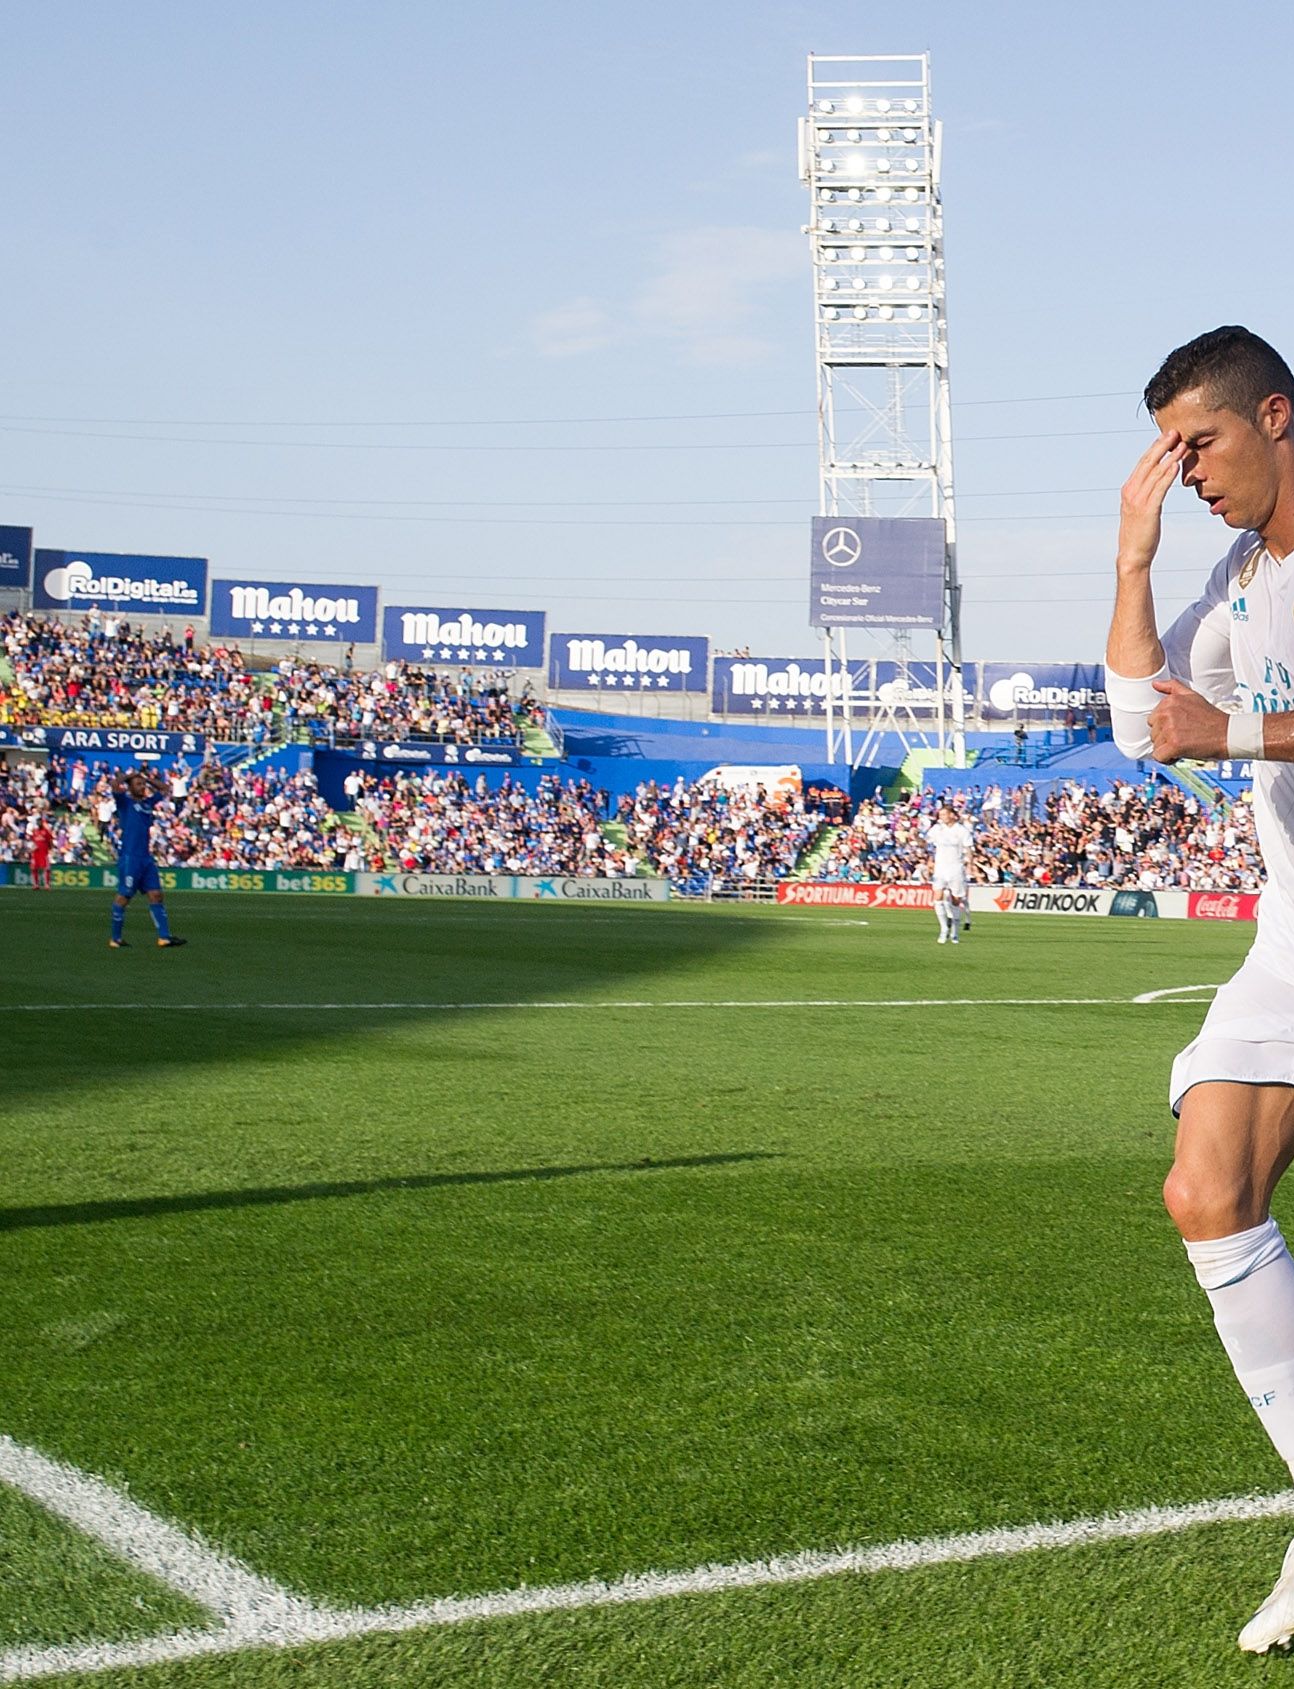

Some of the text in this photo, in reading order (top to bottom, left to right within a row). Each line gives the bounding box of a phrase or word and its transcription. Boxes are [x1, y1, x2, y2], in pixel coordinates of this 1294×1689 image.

[230, 586, 361, 623] Mahou
[400, 612, 529, 648] Mahou
[567, 639, 693, 674] Mahou
[1014, 686, 1107, 708] RolDigita
[61, 730, 170, 751] ARA SPORT
[14, 867, 91, 887] b365
[191, 871, 347, 892] bet365 bet365
[402, 874, 653, 900] CaixaBank CaixaBank
[868, 883, 935, 907] SPORTIU
